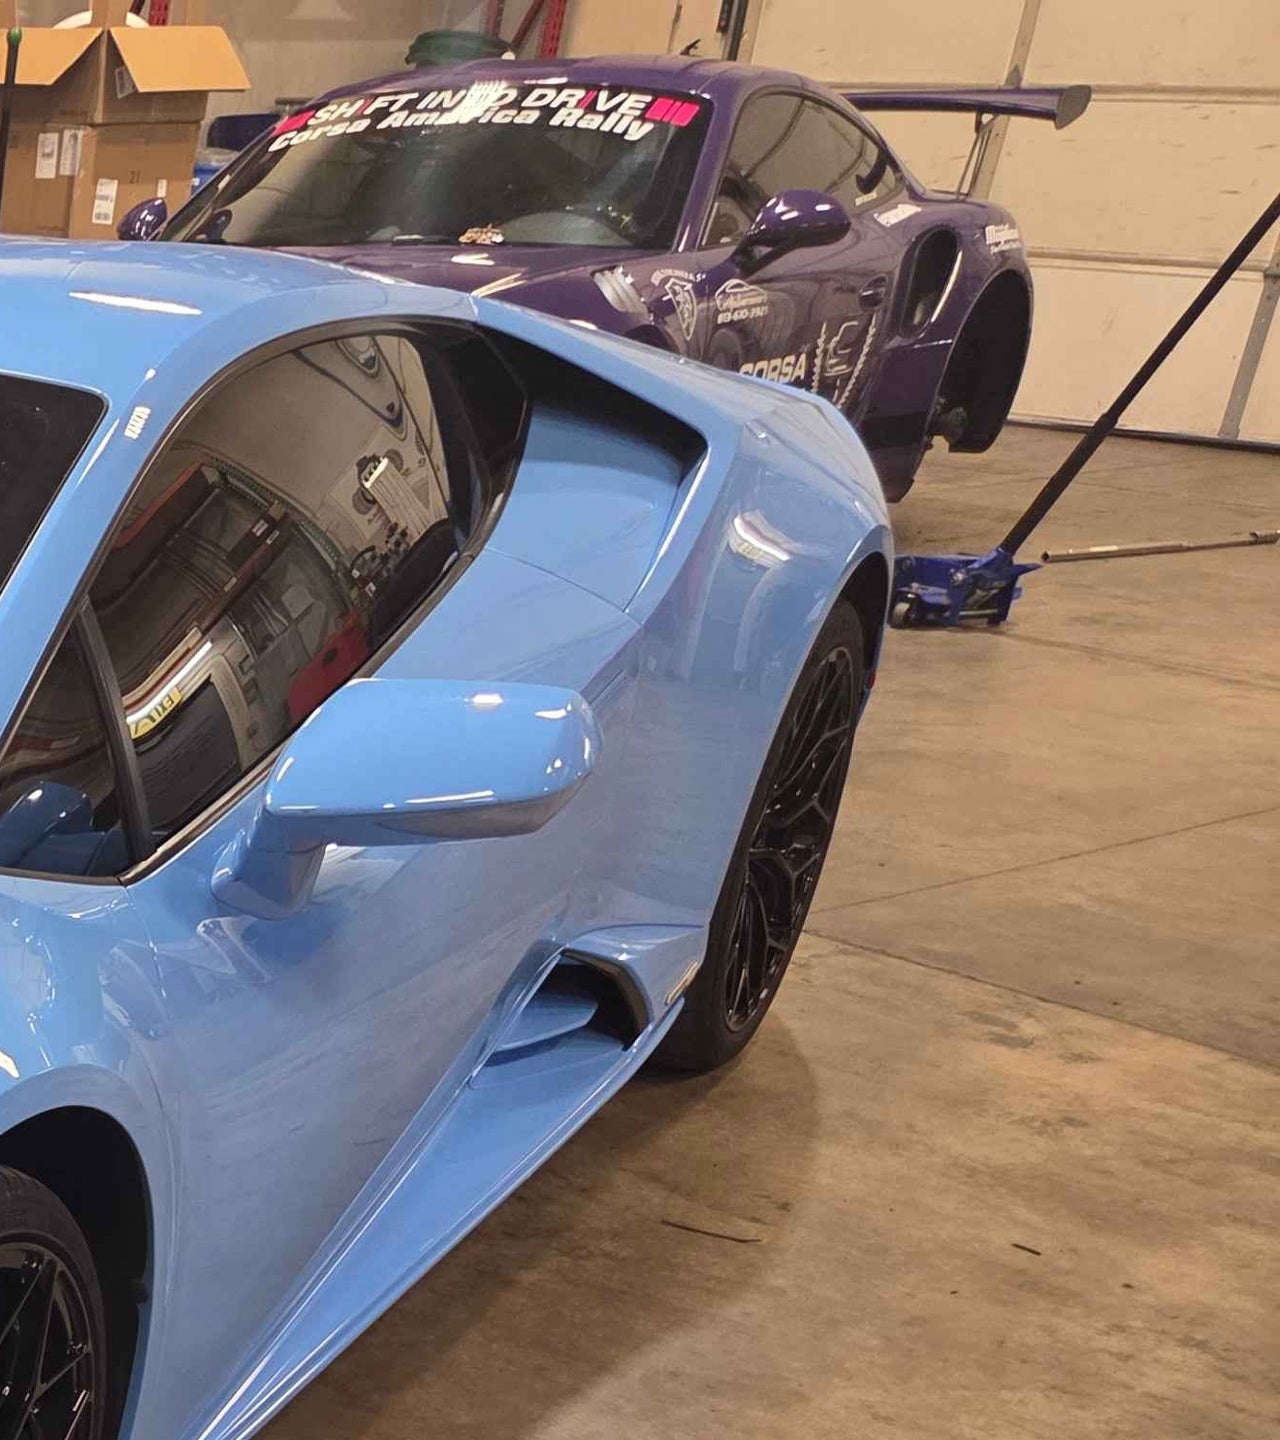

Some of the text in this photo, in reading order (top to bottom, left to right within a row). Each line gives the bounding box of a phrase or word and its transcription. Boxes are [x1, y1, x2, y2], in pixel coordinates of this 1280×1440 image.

[307, 84, 653, 126] SHIFT INO DRIVE
[268, 118, 371, 151] Corsa
[548, 107, 655, 141] Rally
